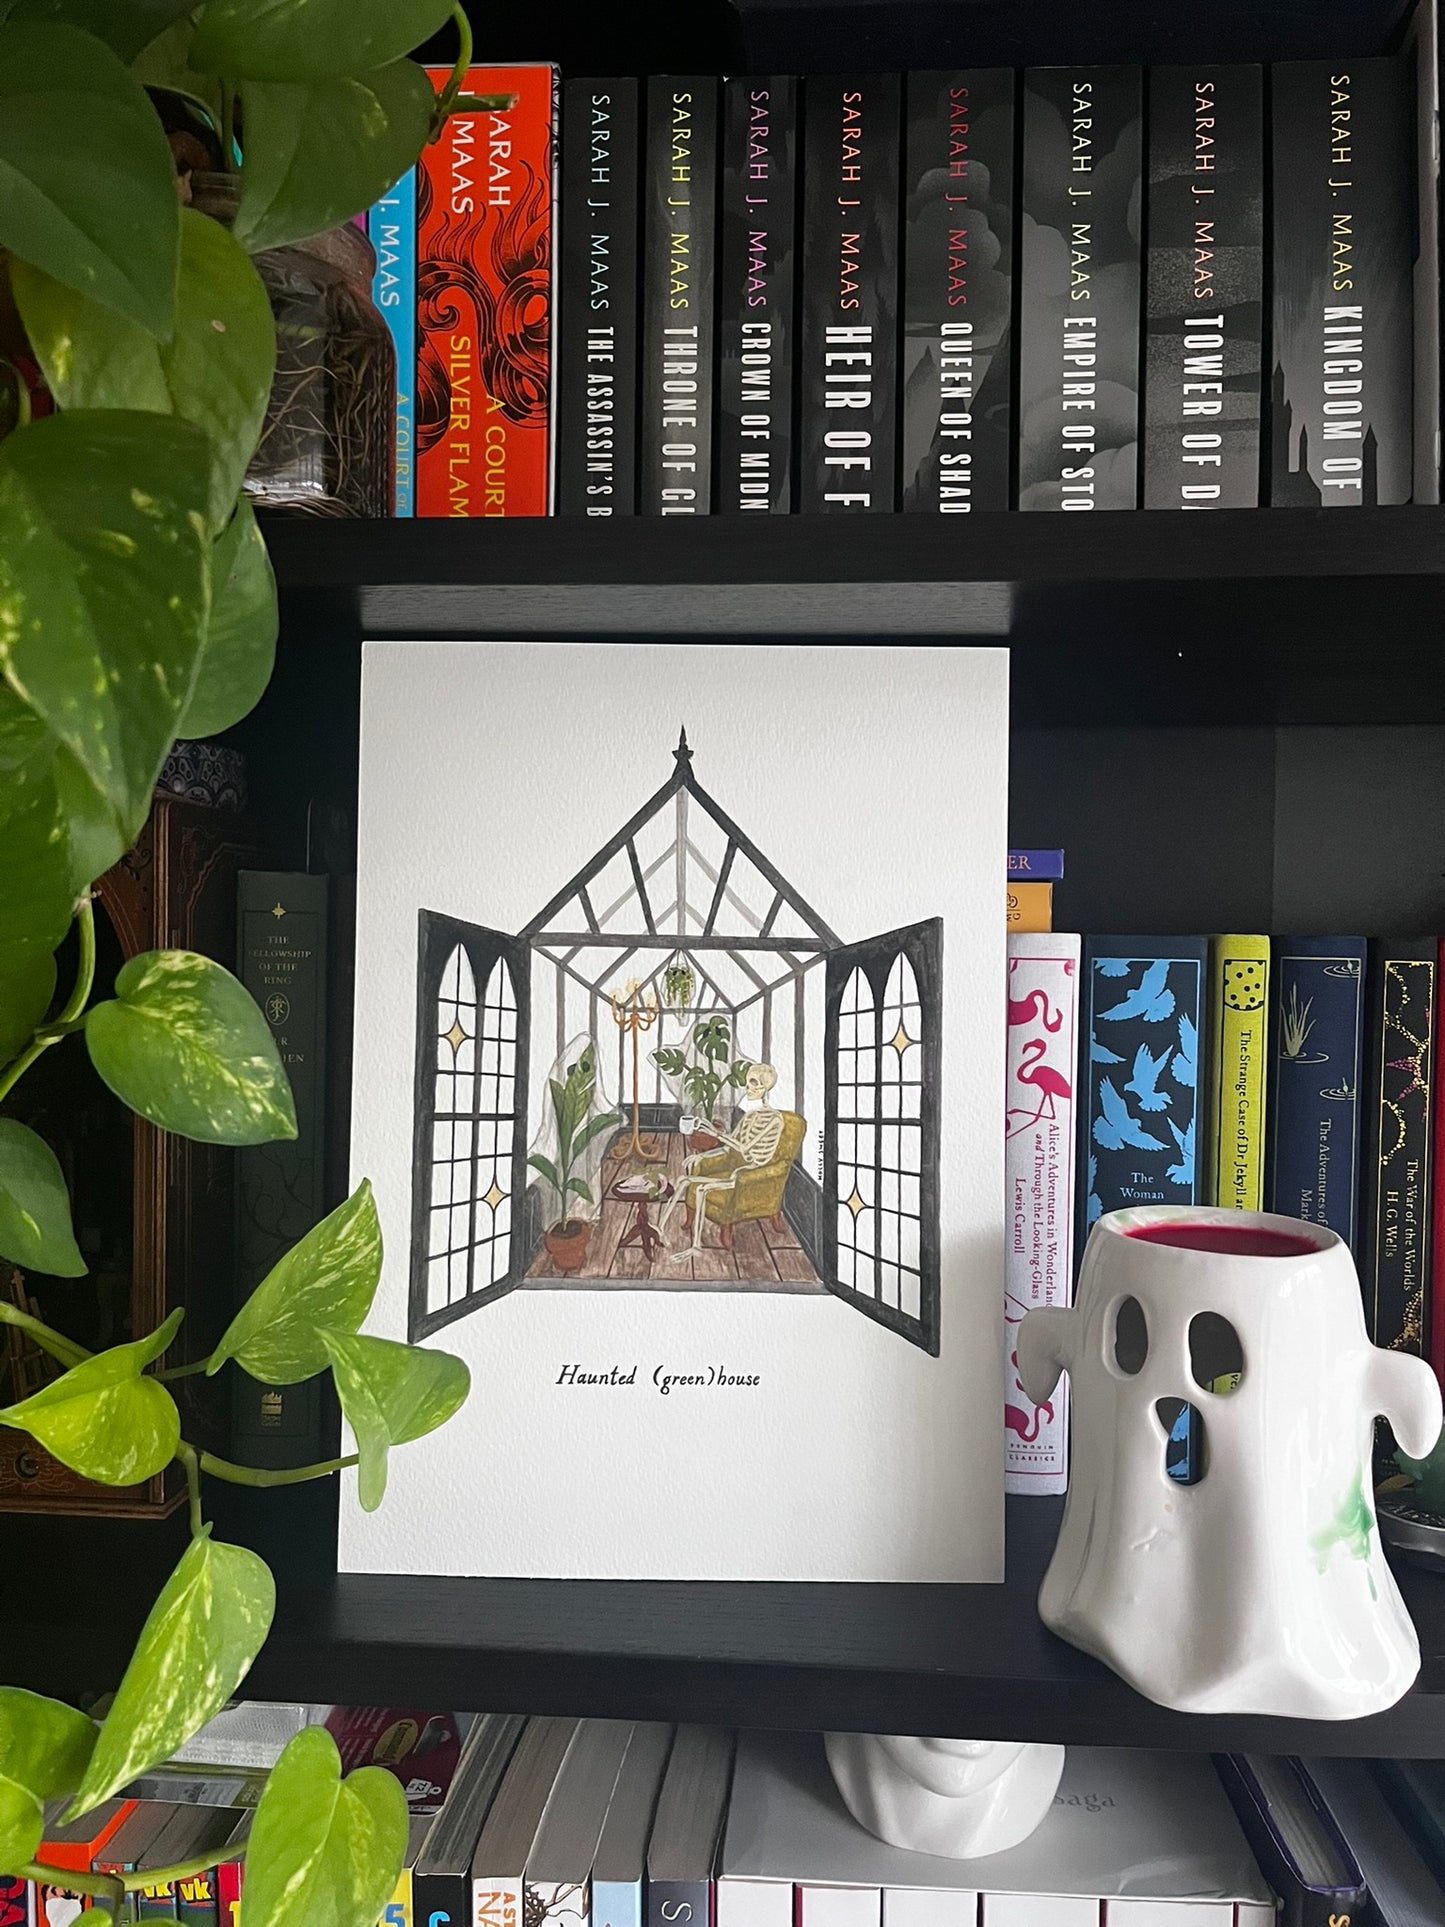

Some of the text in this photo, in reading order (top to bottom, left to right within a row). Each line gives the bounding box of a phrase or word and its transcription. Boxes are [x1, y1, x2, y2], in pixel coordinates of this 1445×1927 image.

[452, 120, 474, 214] MAAS
[488, 110, 512, 206] ARAH
[945, 88, 969, 306] SARAH J. MAAS
[1068, 83, 1092, 300] SARAH J. MAAS
[1191, 82, 1215, 299] SARAH J. MAAS
[1328, 75, 1353, 291] SARAH J. MAAS
[587, 95, 610, 310] SARAH J. MAAS
[668, 93, 692, 310] SARAH J. MAAS
[746, 91, 770, 307] SARAH J. MAAS
[838, 92, 862, 310] SARAH J. MAAS
[380, 225, 400, 306] MAAS
[450, 335, 471, 430] SILVER
[587, 326, 614, 363] THE
[662, 326, 698, 428] THRONE
[486, 394, 506, 414] A
[586, 374, 614, 495] ASSASSIN'S
[740, 323, 772, 510] CROWN OF MIDN
[824, 326, 872, 507] HEIR OF F
[939, 322, 973, 514] QUEEN OF SHAD
[1060, 317, 1097, 511] EMPIRE OF STO
[1181, 314, 1224, 510] TOWER OF D
[1322, 306, 1364, 490] KINGDOM OF
[396, 415, 410, 488] COURT
[662, 443, 696, 472] OF
[267, 936, 290, 944] THE
[274, 963, 298, 972] THE
[264, 976, 292, 984] RING
[1234, 1054, 1250, 1096] Strange
[1240, 1030, 1252, 1052] The
[1048, 1123, 1060, 1160] Alice's
[1236, 1143, 1248, 1160] Dr
[1238, 1100, 1249, 1126] Case
[1238, 1128, 1248, 1142] of
[1046, 1162, 1059, 1226] Adventures
[1120, 1188, 1164, 1200] Woman
[1130, 1172, 1154, 1184] The
[1233, 1162, 1247, 1196] Jekyll
[1300, 1189, 1312, 1220] Mark
[1317, 1118, 1332, 1226] The Adventures of
[1014, 1178, 1027, 1254] Lewis Carroll
[1030, 1134, 1045, 1300] and Through the Looking-Glass
[1046, 1228, 1058, 1239] in
[1385, 1190, 1398, 1258] H. G. Wells
[1404, 1158, 1418, 1292] The War of the Worlds
[556, 1364, 760, 1395] Haunted (green)house
[1009, 1454, 1055, 1462] CLASSICS
